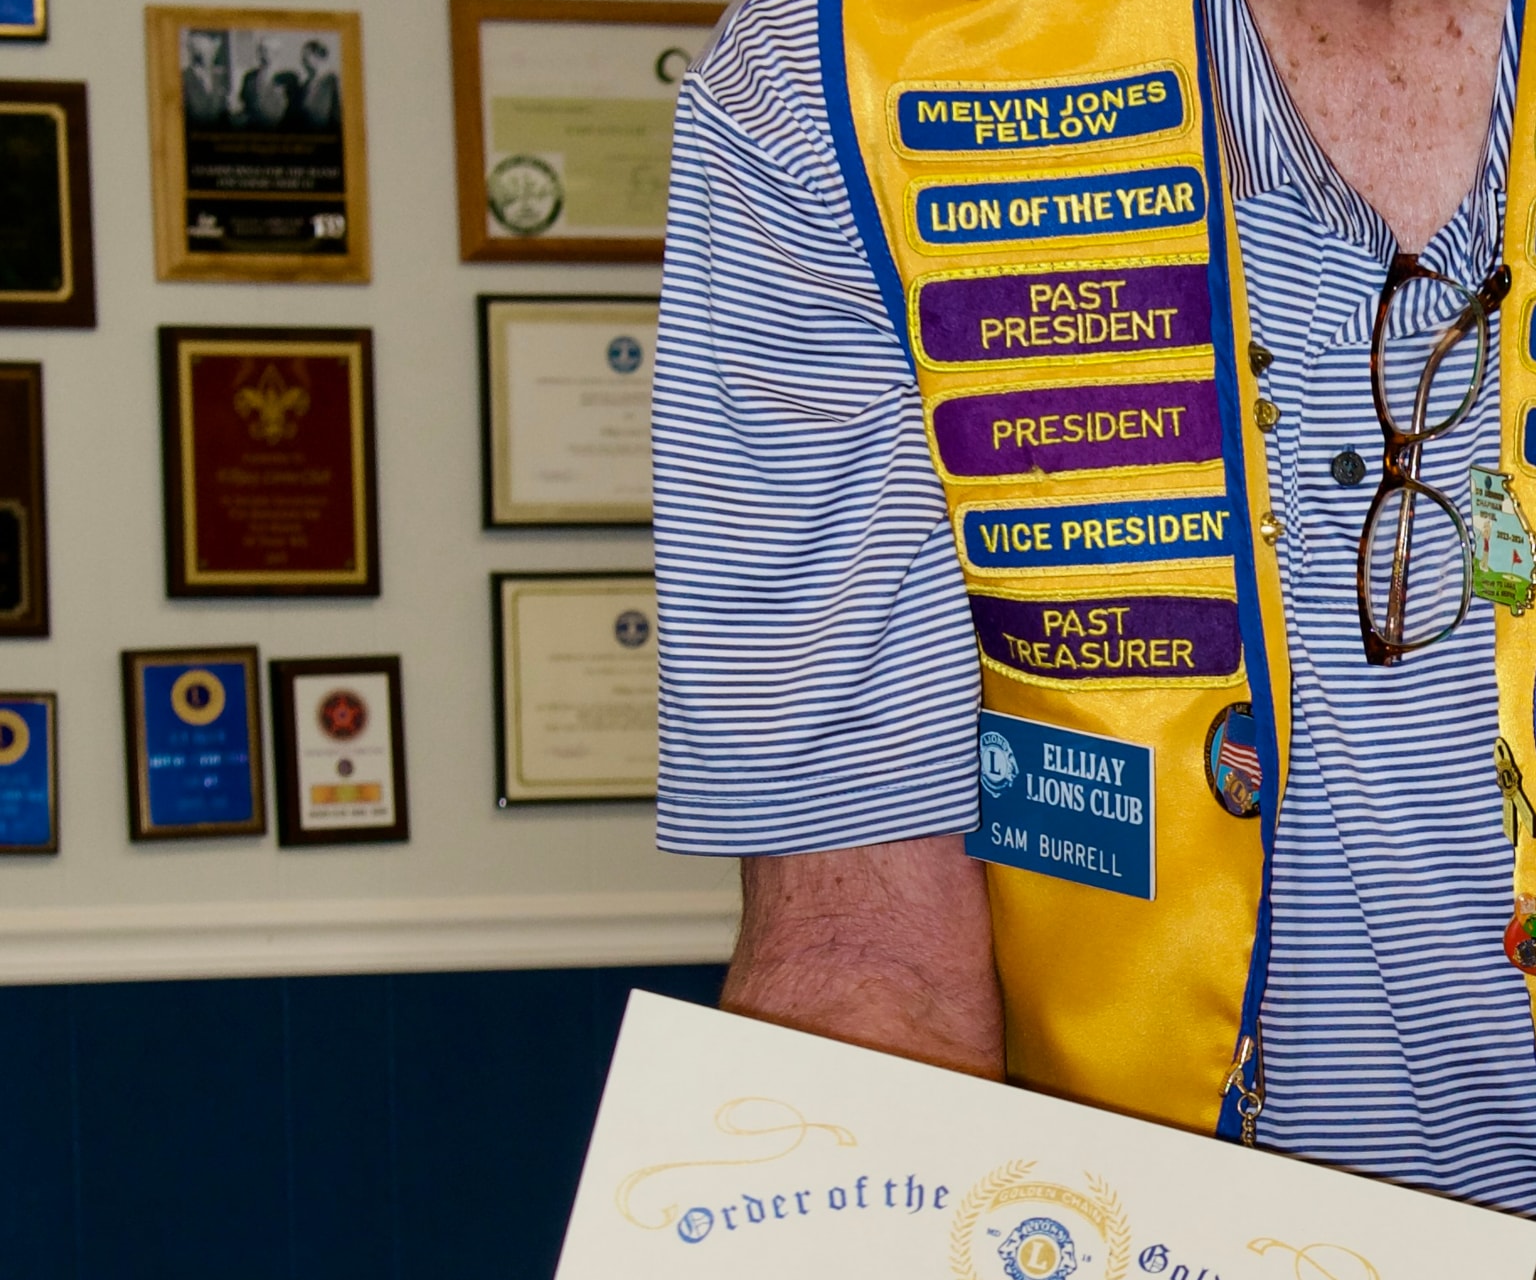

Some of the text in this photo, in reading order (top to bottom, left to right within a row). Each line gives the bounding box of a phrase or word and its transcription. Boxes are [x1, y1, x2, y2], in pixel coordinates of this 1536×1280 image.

[918, 80, 1167, 123] MELVIN JONES
[975, 111, 1117, 145] FELLOW
[931, 182, 1195, 233] LION OF THE YEAR
[1029, 280, 1127, 313] PAST
[980, 308, 1178, 350] PRESIDENT
[992, 406, 1188, 450] PRESIDENT
[979, 510, 1231, 553] VICE PRESIDEN
[1043, 606, 1130, 638] PAST
[1003, 632, 1194, 670] TREASURER
[1042, 742, 1126, 787] ELLIJAY
[1026, 772, 1143, 826] LIONS CLUB
[991, 822, 1123, 878] SAM BURRELL
[677, 1173, 950, 1244] Order of the
[999, 1186, 1104, 1224] GOLDEN CHAIN
